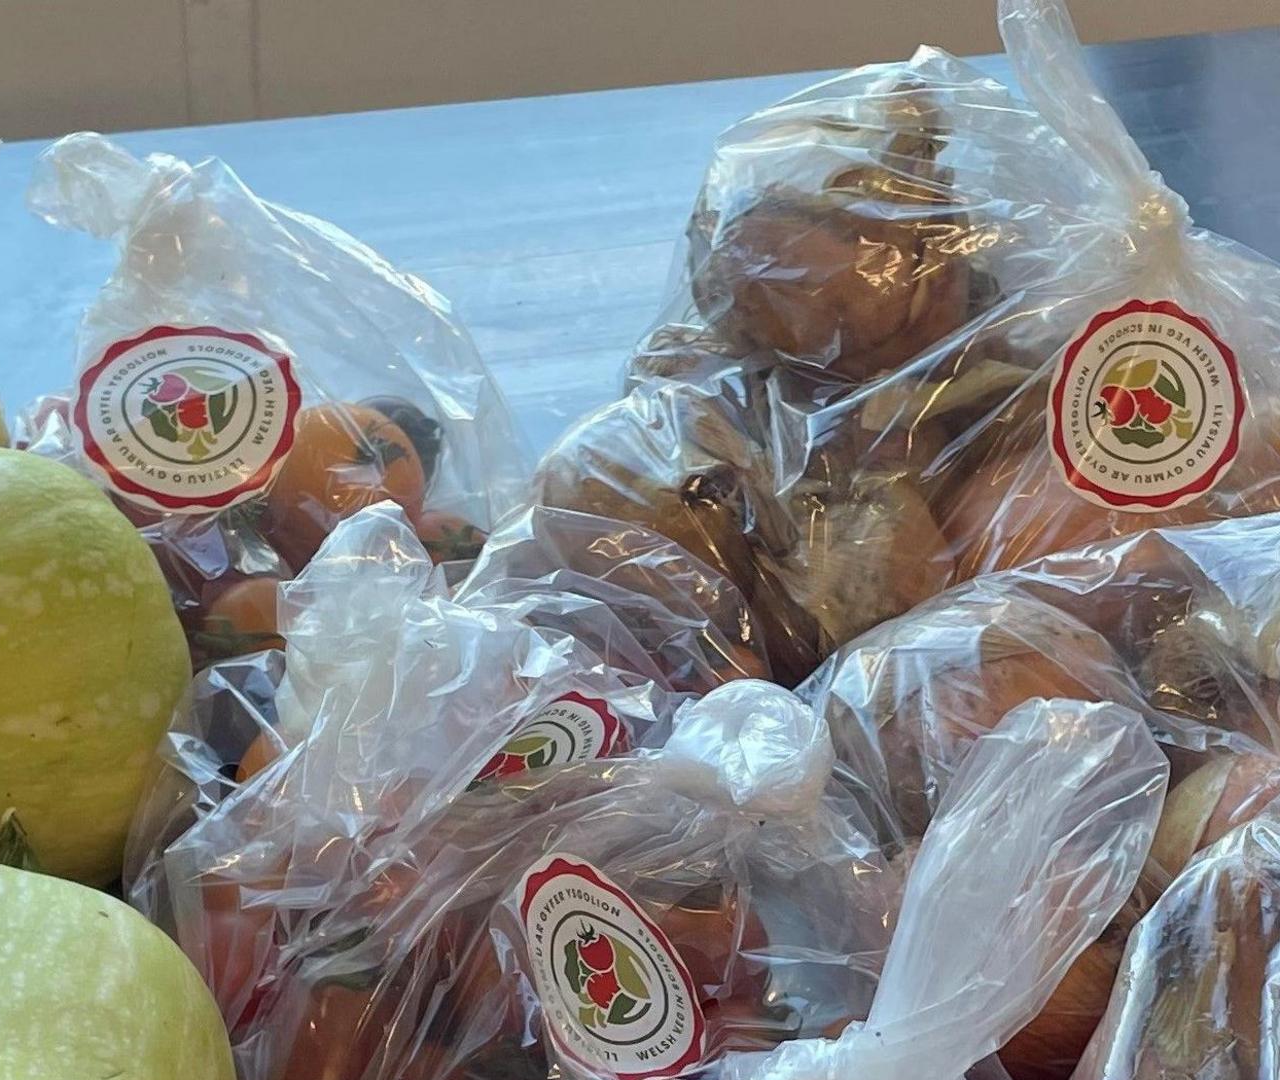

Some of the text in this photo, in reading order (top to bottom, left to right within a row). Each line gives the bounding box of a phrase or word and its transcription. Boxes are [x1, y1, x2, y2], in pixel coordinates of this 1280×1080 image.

[1098, 323, 1219, 386] WELSH VEG IN SCHOOLS
[259, 369, 274, 394] VEG
[1071, 366, 1090, 438] YSGOLION
[106, 427, 122, 443] AR
[252, 400, 276, 445] WELSH
[1197, 404, 1223, 460] LLYSIAU
[118, 446, 166, 480] GYMRU
[1110, 469, 1129, 482] AR
[1134, 465, 1183, 484] GYMRU
[1186, 459, 1196, 467] O
[173, 474, 182, 482] O
[536, 923, 544, 945] AR
[541, 893, 565, 921] GYFER
[566, 889, 621, 917] YSGOLION
[638, 928, 680, 991] SCHOOLS
[675, 994, 683, 1008] IN
[636, 1036, 676, 1061] WELSH
